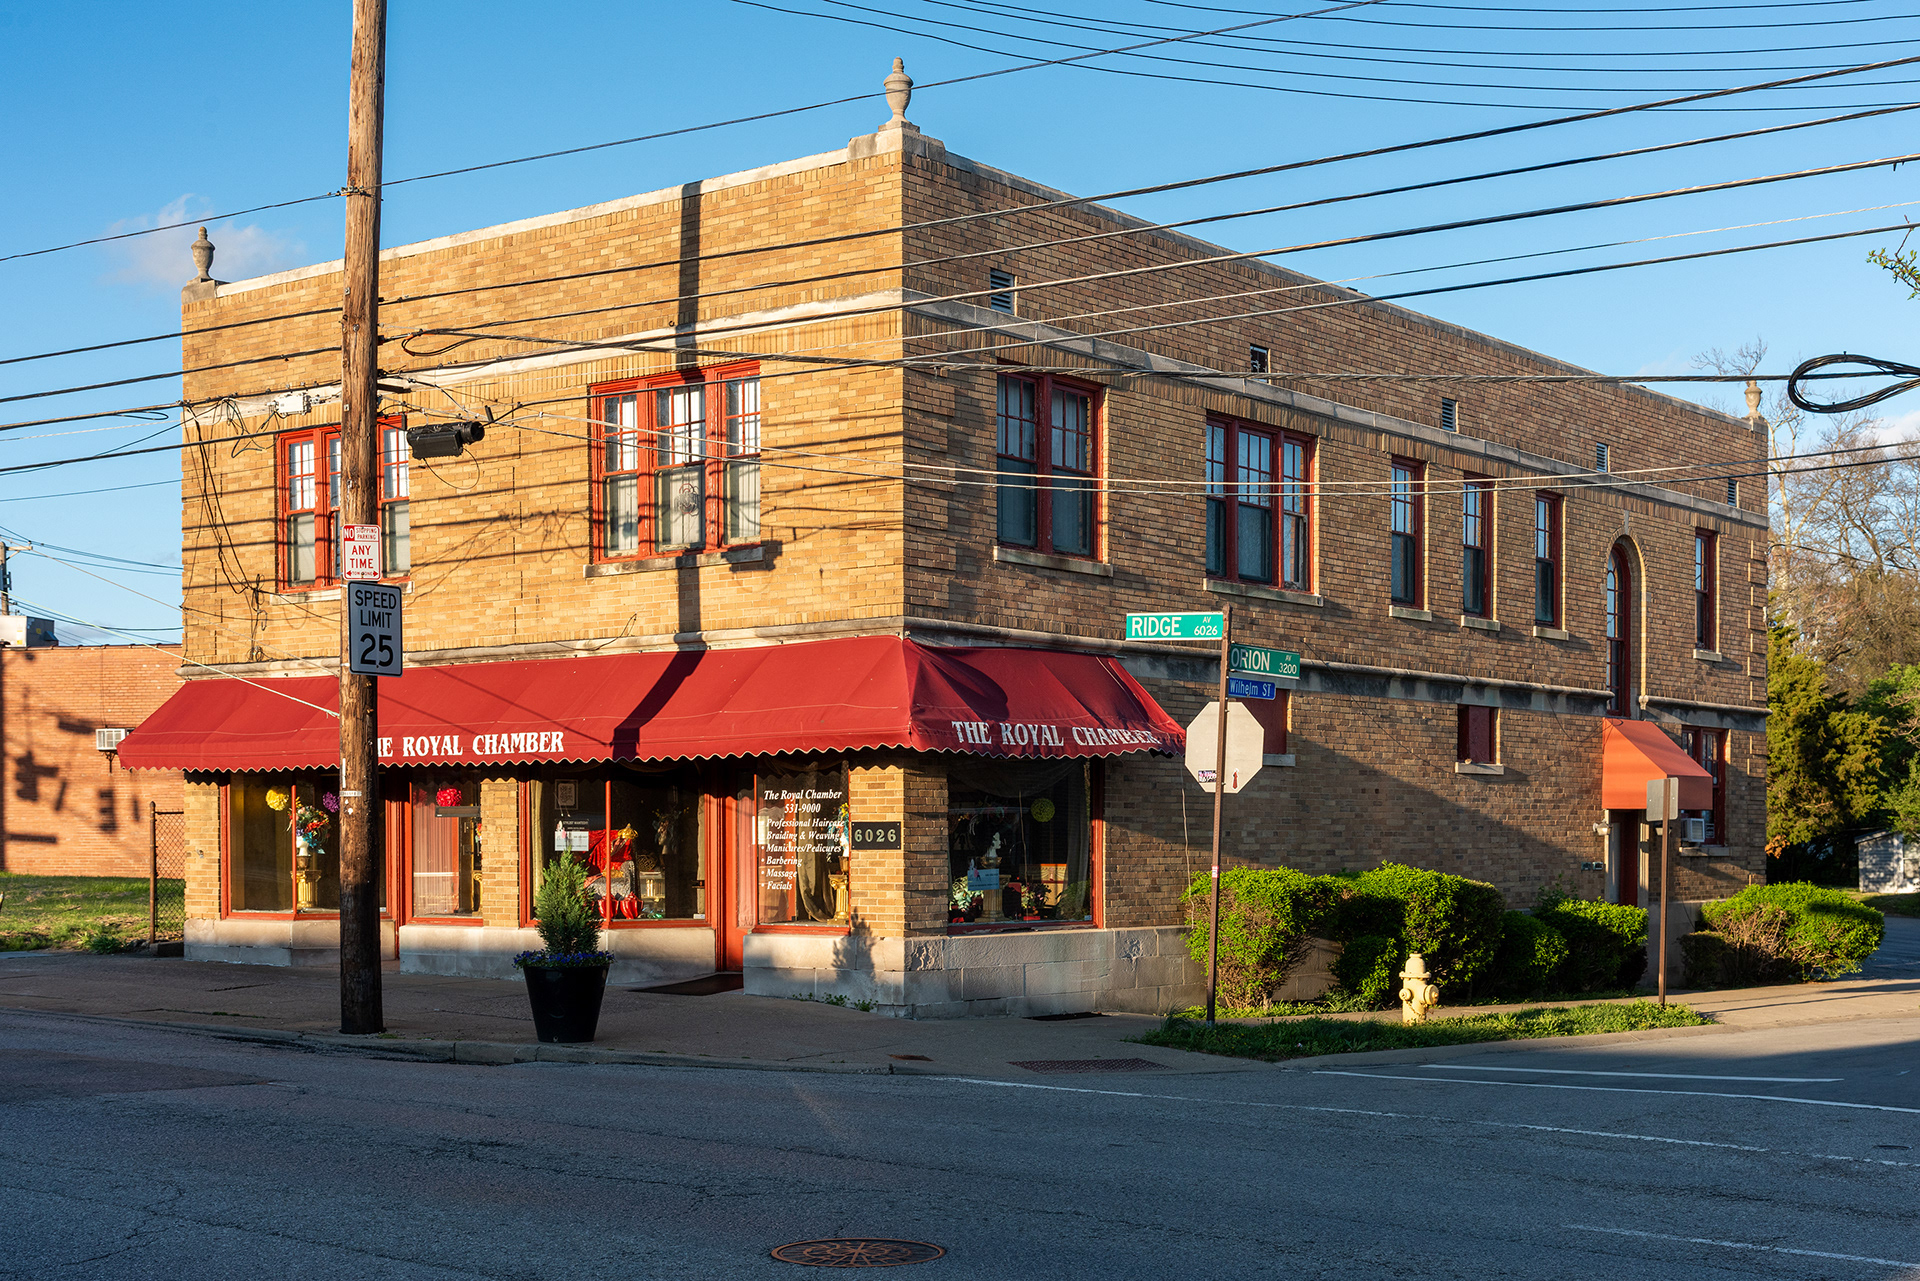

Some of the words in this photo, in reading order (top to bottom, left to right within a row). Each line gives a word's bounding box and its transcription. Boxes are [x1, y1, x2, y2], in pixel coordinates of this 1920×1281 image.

[343, 527, 355, 539] NO
[352, 545, 371, 555] ANY
[350, 559, 373, 568] TIME
[355, 589, 396, 610] SPEED
[360, 610, 392, 628] LIMIT
[1131, 617, 1182, 636] RIDGE
[1194, 625, 1218, 636] 6026
[360, 633, 394, 667] 25
[1231, 648, 1270, 671] ORION
[1278, 663, 1297, 674] 3200
[1229, 679, 1259, 696] Wilhelm
[1262, 683, 1272, 697] ST
[951, 721, 992, 744] THE
[1000, 722, 1064, 746] ROYAL
[1072, 726, 1162, 746] CHAMBER
[402, 735, 463, 757] ROYAL
[472, 731, 564, 755] CHAMBER
[764, 790, 780, 800] The
[780, 790, 803, 802] Royal
[805, 789, 842, 800] Chamber
[784, 803, 821, 813] 531-9000
[766, 818, 811, 829] Professional
[812, 818, 845, 827] Haircare
[766, 831, 798, 842] Braiding
[800, 831, 806, 840] &
[808, 831, 841, 842] Weaving
[854, 829, 897, 842] 6026
[766, 843, 841, 853] Manicures/Pedicures
[766, 856, 802, 867] Barbering
[766, 868, 797, 879] Massage
[767, 881, 792, 890] Facials
